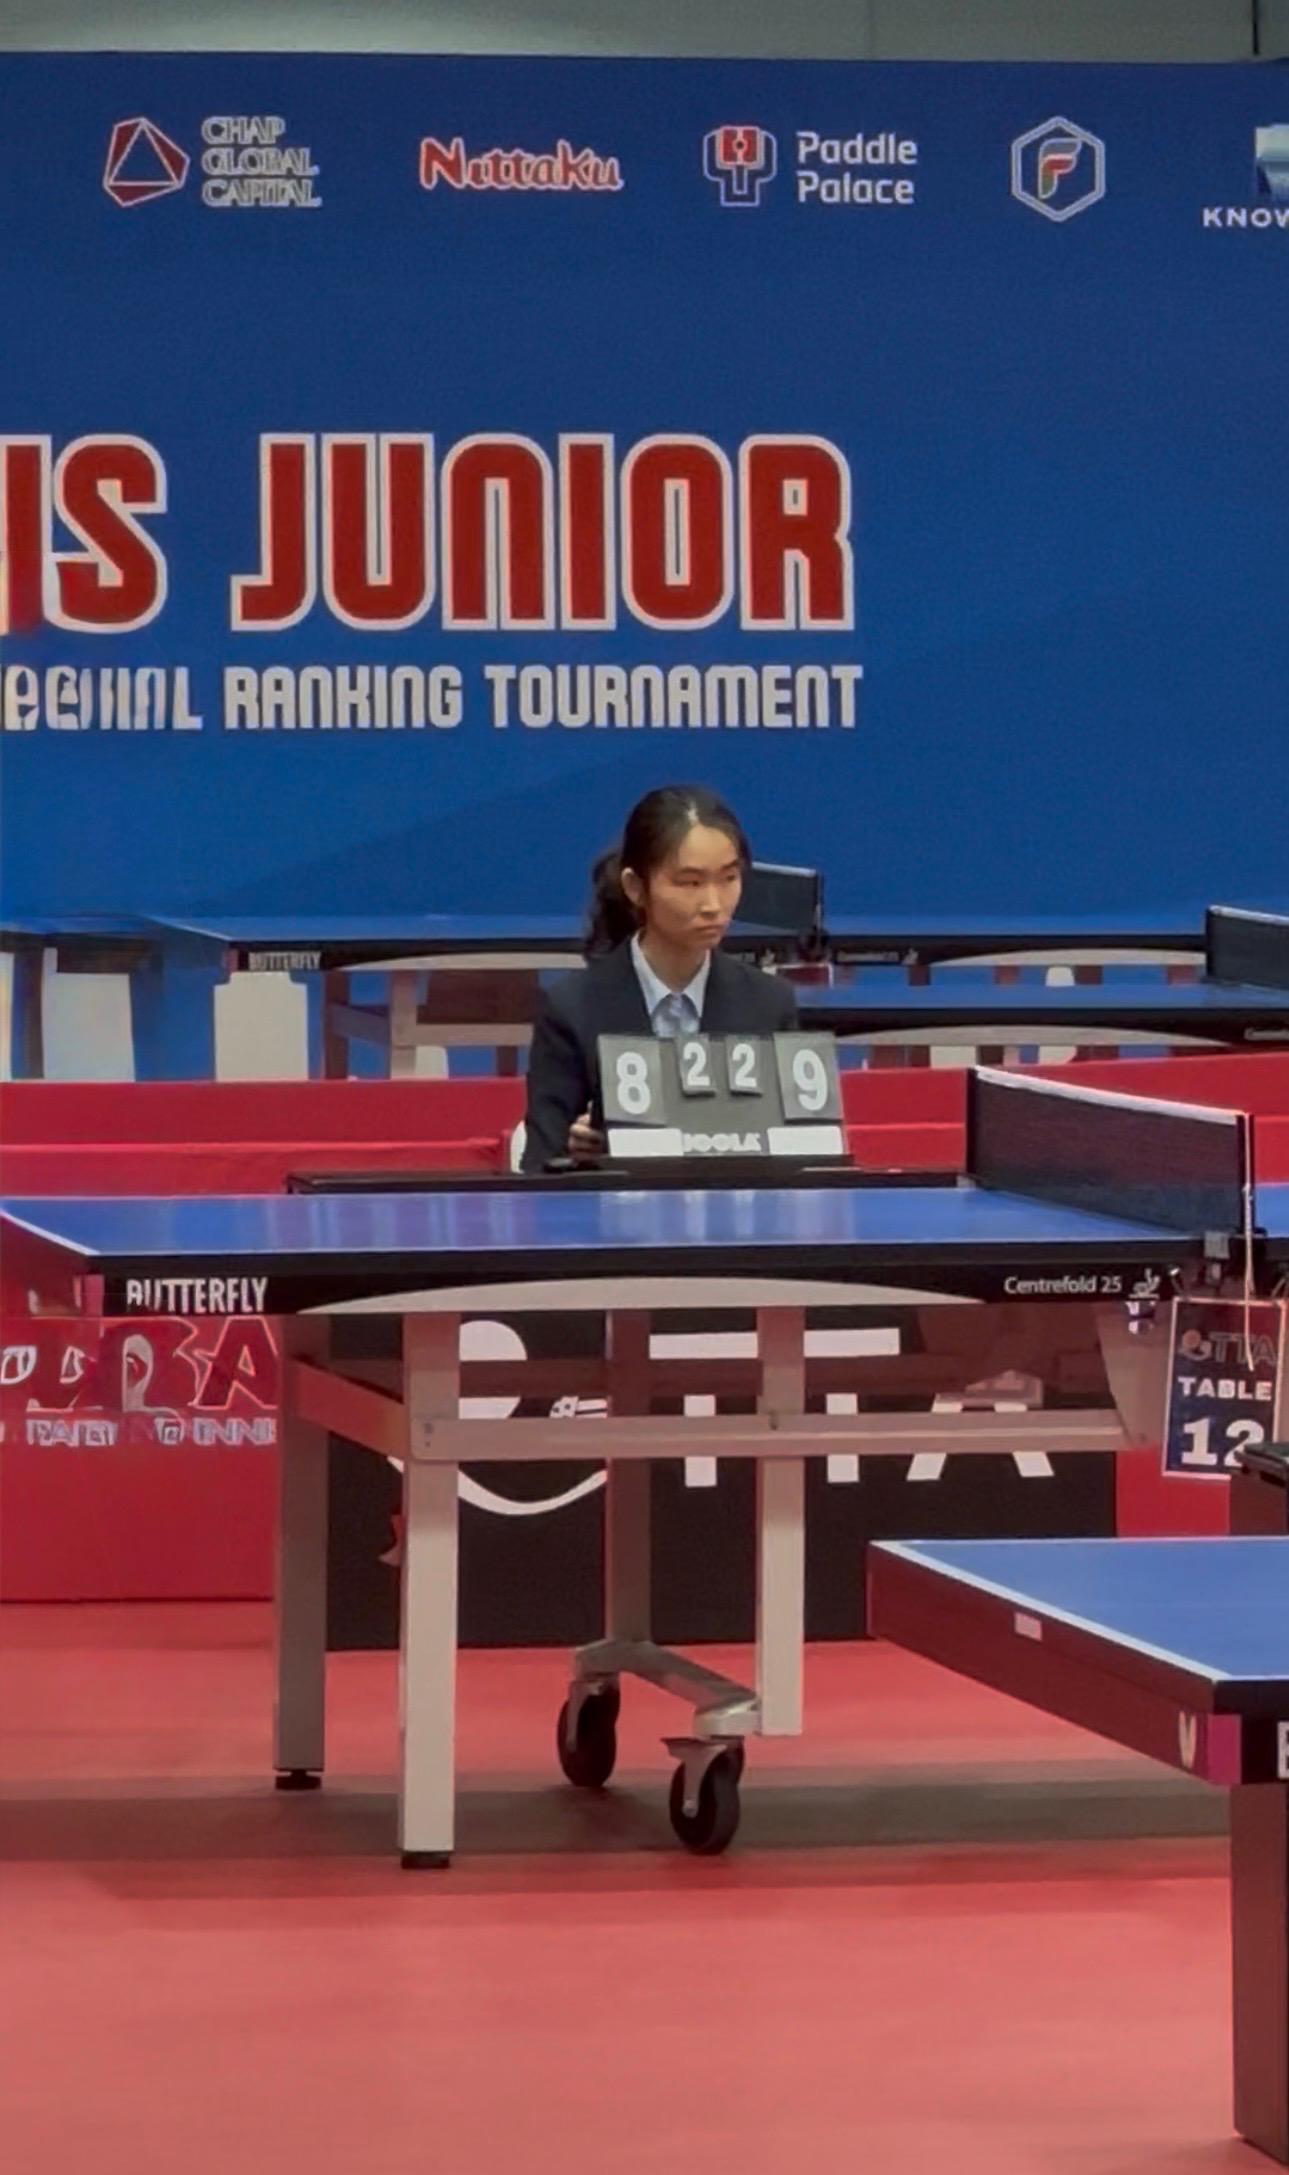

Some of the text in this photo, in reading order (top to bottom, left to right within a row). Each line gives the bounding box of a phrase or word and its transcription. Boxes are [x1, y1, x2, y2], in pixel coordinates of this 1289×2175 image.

[201, 116, 286, 144] CHAP
[201, 147, 320, 175] GLOBAL
[420, 137, 625, 190] Nittaku
[796, 131, 918, 164] Paddle
[201, 179, 323, 207] CAPITAL
[796, 170, 915, 204] Palace
[231, 432, 855, 631] JUNIOR
[224, 665, 463, 728] RANKING
[484, 664, 864, 728] TOURNAMENT
[615, 1042, 828, 1115] 8 2 2 9
[1004, 1276, 1122, 1295] Centrefold 25
[1178, 1376, 1272, 1401] TABLE
